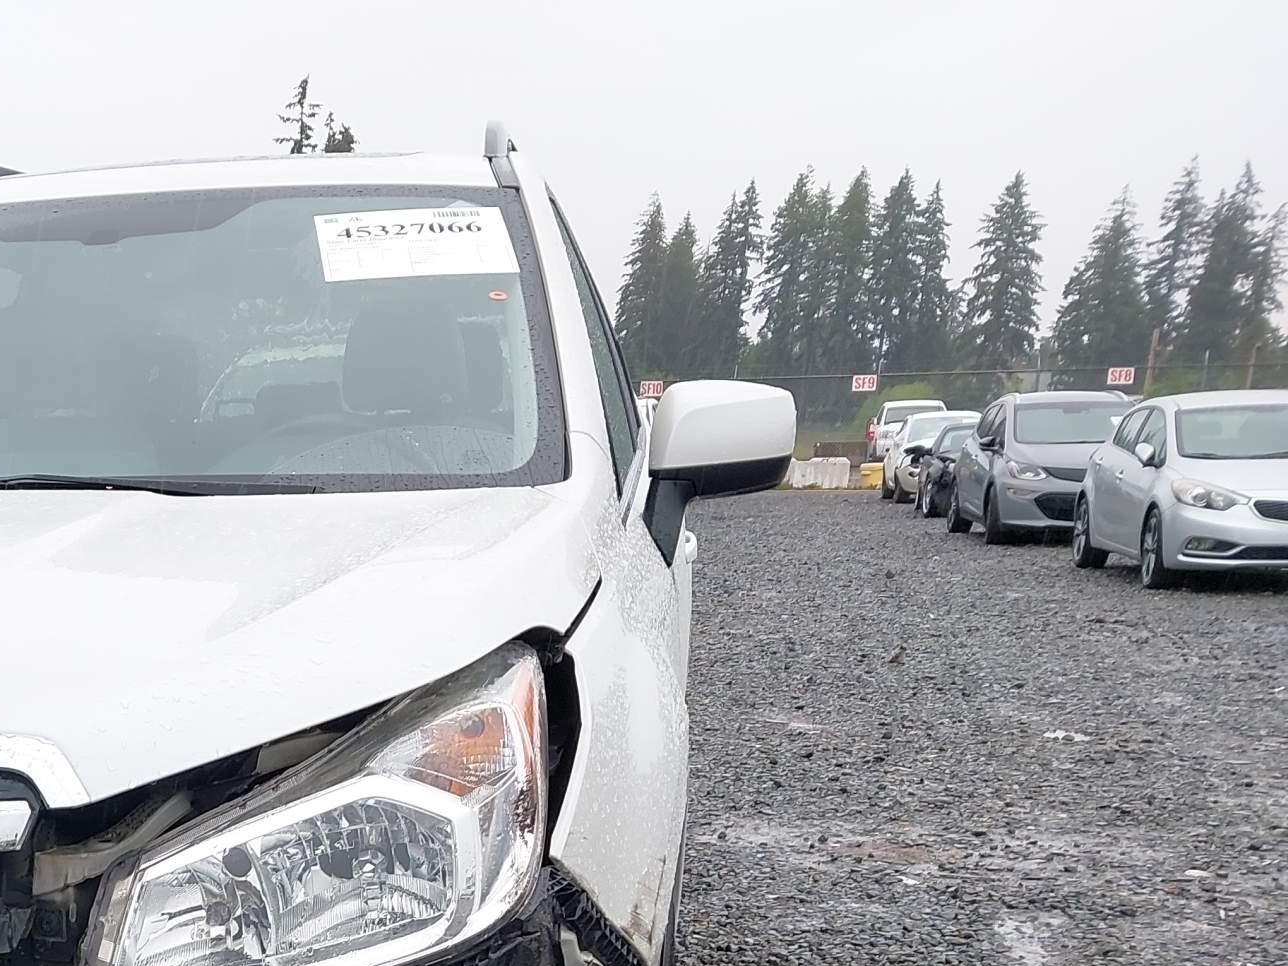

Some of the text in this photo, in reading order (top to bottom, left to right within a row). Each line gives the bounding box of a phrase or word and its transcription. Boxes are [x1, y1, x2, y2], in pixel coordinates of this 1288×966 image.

[336, 220, 483, 239] 45327066
[853, 375, 876, 390] SF9
[1110, 368, 1133, 383] SF8
[641, 381, 663, 395] SF10
